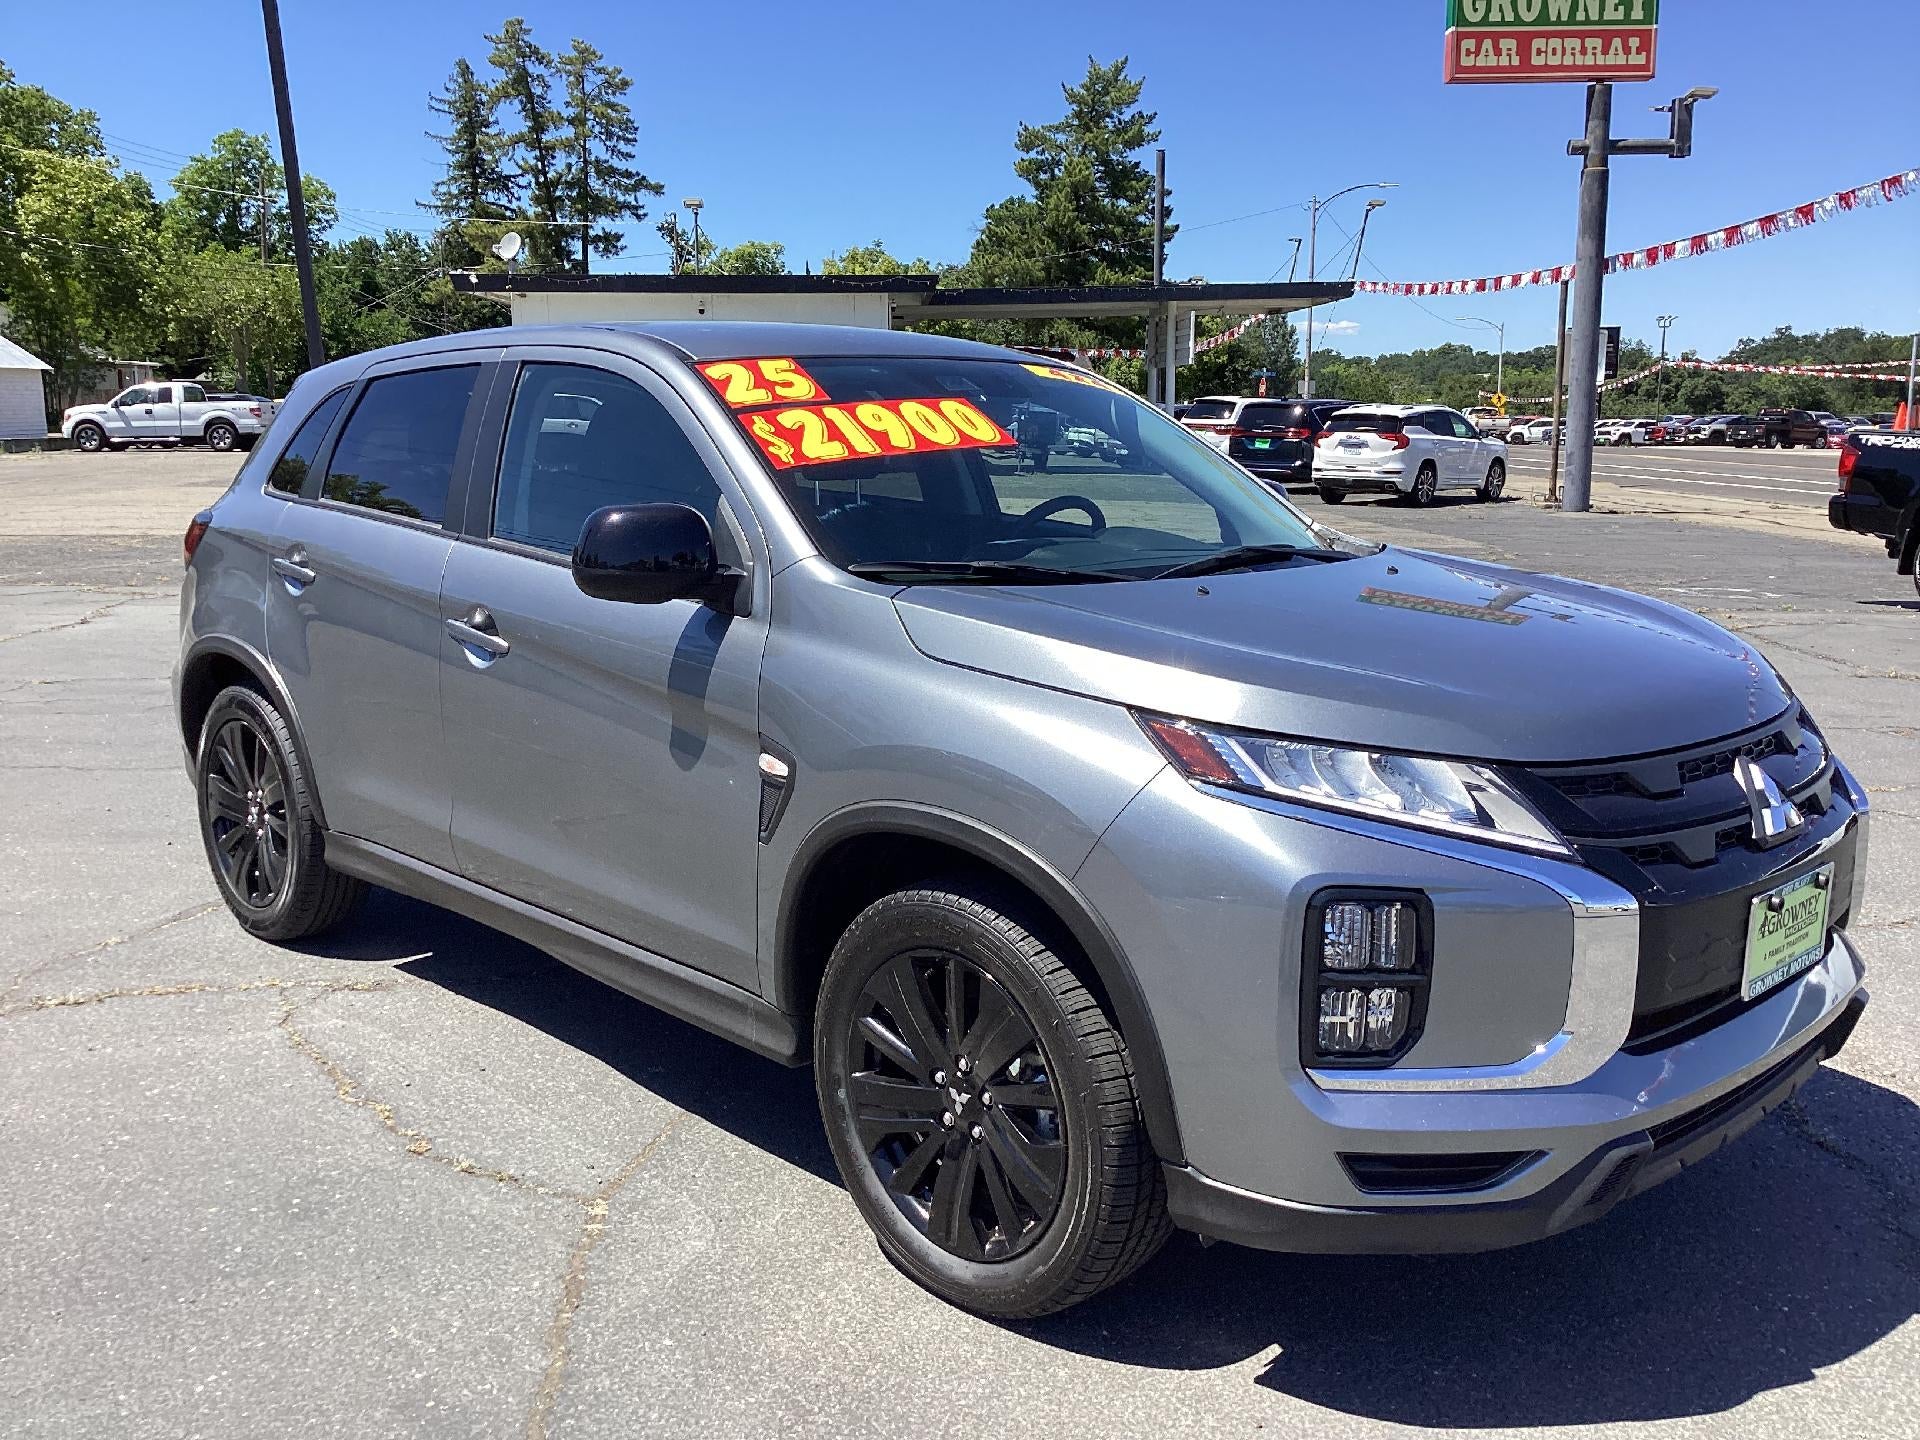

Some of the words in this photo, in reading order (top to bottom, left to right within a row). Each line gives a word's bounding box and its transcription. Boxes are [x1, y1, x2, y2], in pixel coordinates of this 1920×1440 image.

[1460, 38, 1520, 66] CAR
[1531, 37, 1646, 66] CORRAL
[705, 358, 816, 404] 25
[752, 400, 1001, 464] $21900
[1767, 891, 1822, 935] GROWNEY
[1750, 966, 1788, 996] GROWNEY
